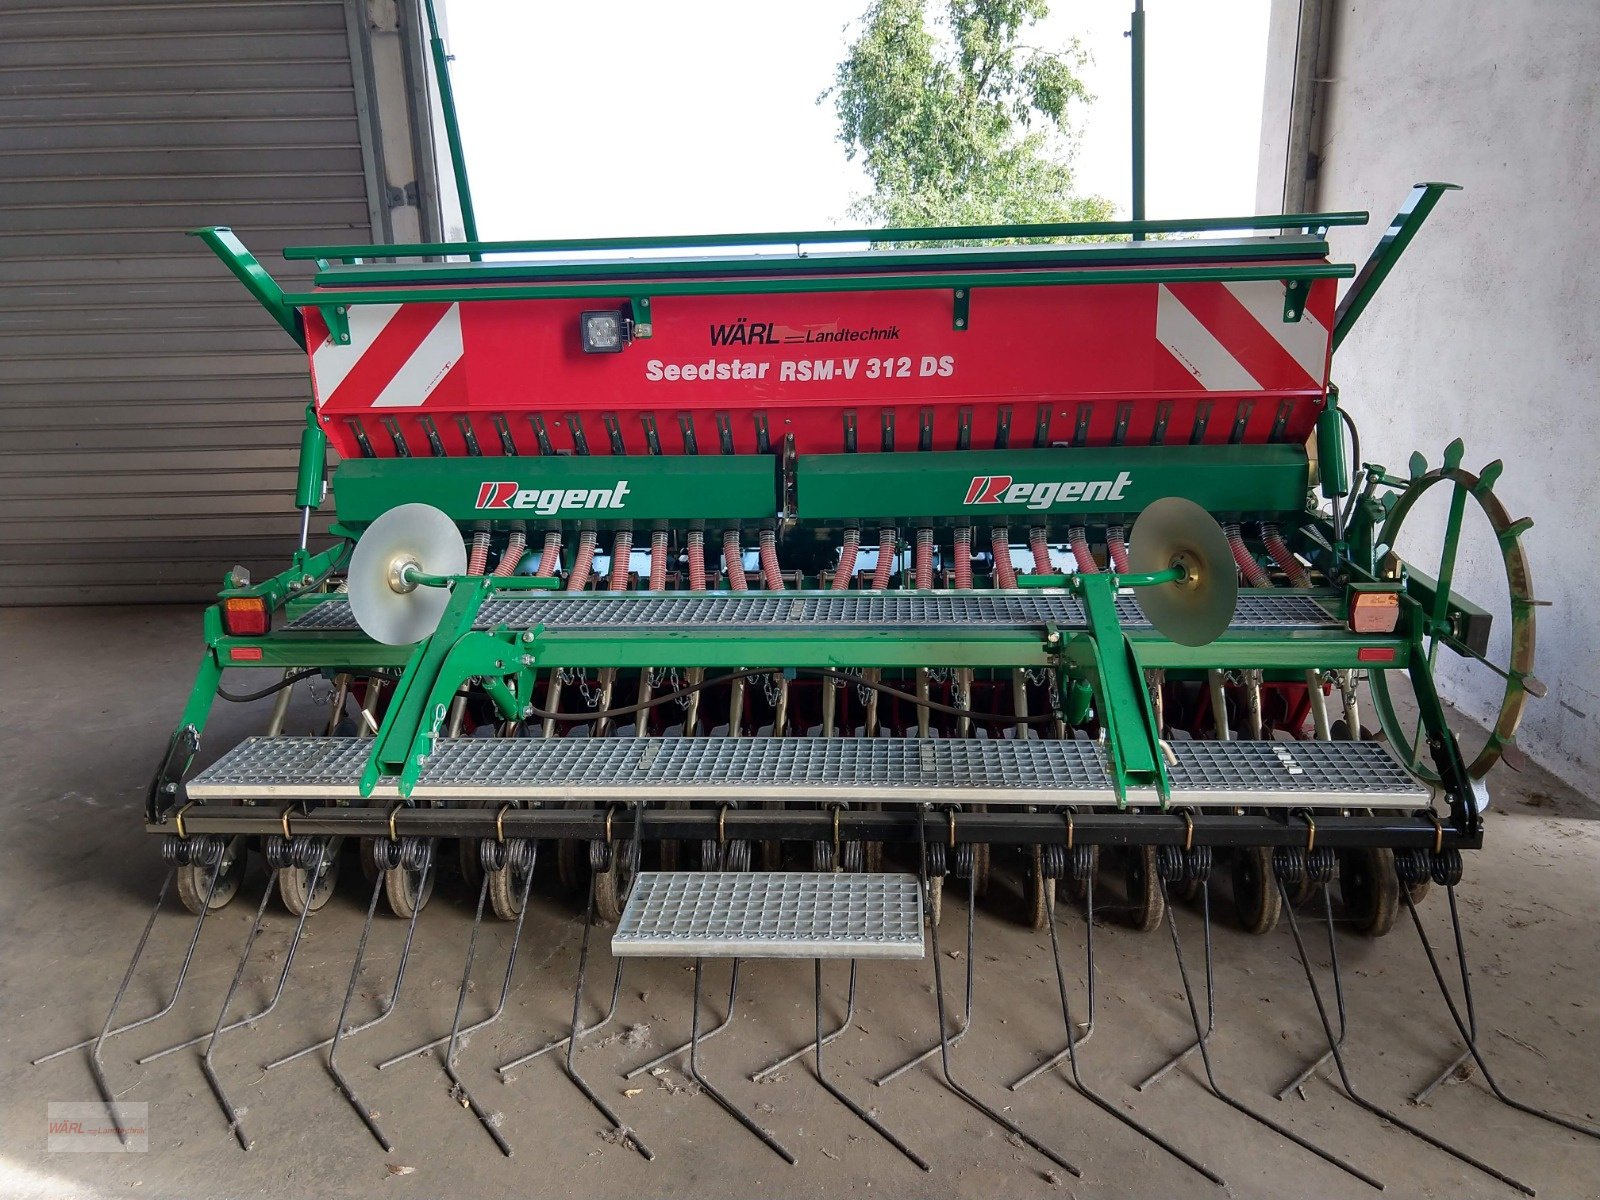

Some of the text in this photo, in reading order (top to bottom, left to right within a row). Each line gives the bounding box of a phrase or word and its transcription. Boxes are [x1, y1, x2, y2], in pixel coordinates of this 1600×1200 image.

[710, 318, 900, 346] WÄRL Landtechnik
[645, 355, 954, 382] Seedstar RSM-V 312 DS
[475, 480, 630, 515] Regent
[963, 471, 1132, 510] Regent
